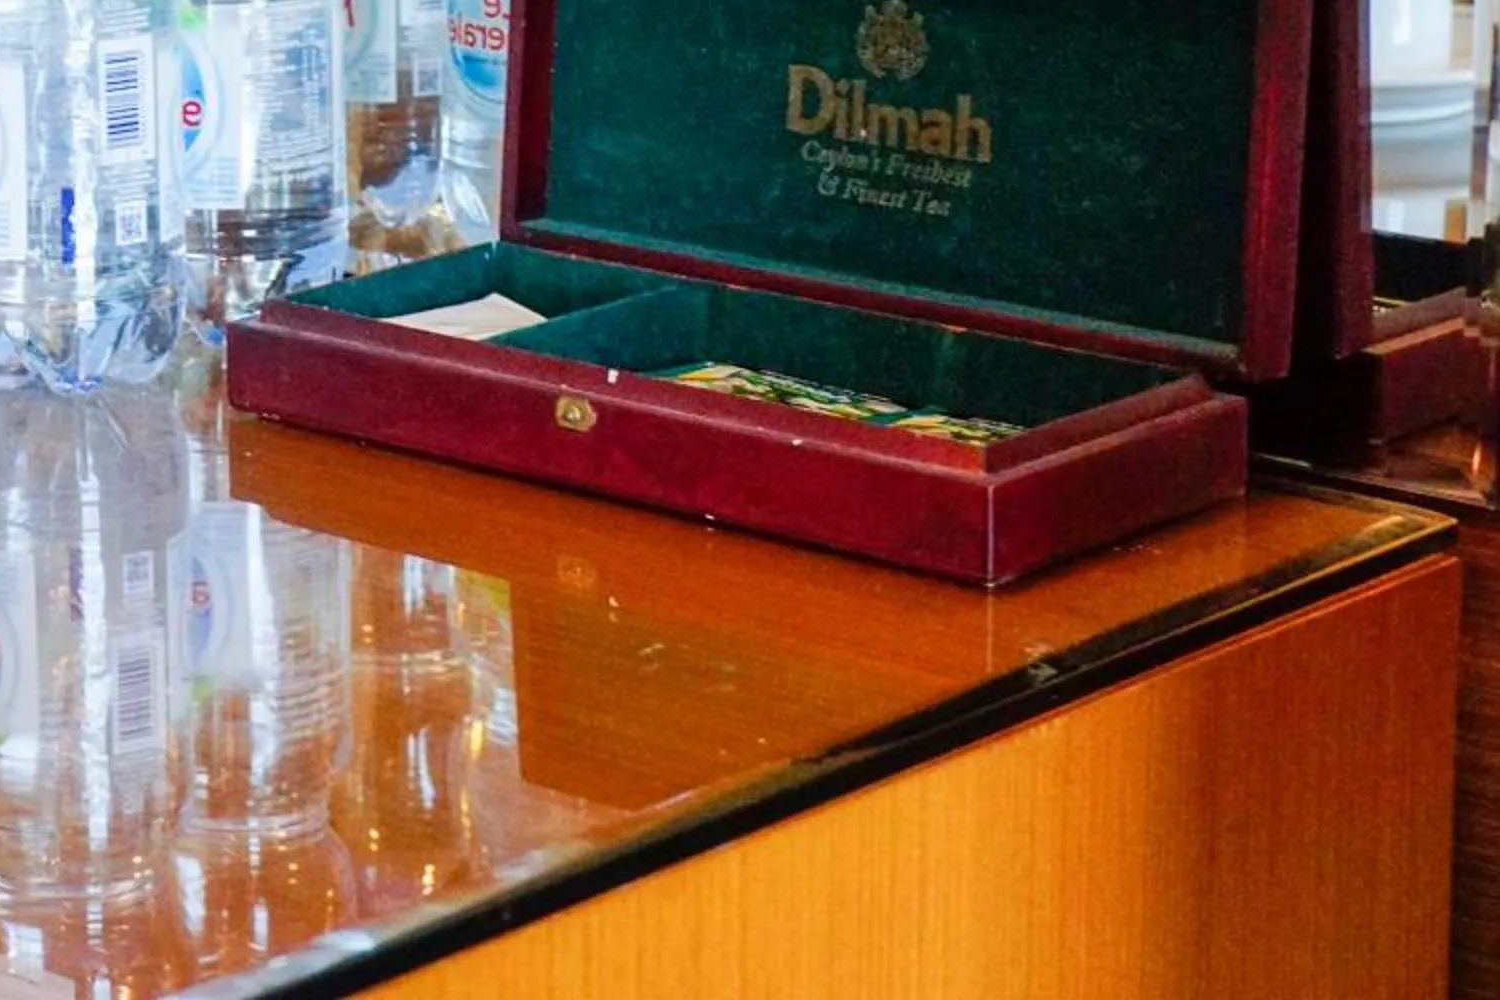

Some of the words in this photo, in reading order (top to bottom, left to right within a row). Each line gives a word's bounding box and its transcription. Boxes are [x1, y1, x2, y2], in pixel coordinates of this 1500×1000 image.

[786, 63, 992, 164] Dilmah
[817, 171, 841, 196] &
[843, 178, 908, 208] Finest
[911, 190, 951, 217] Tea
